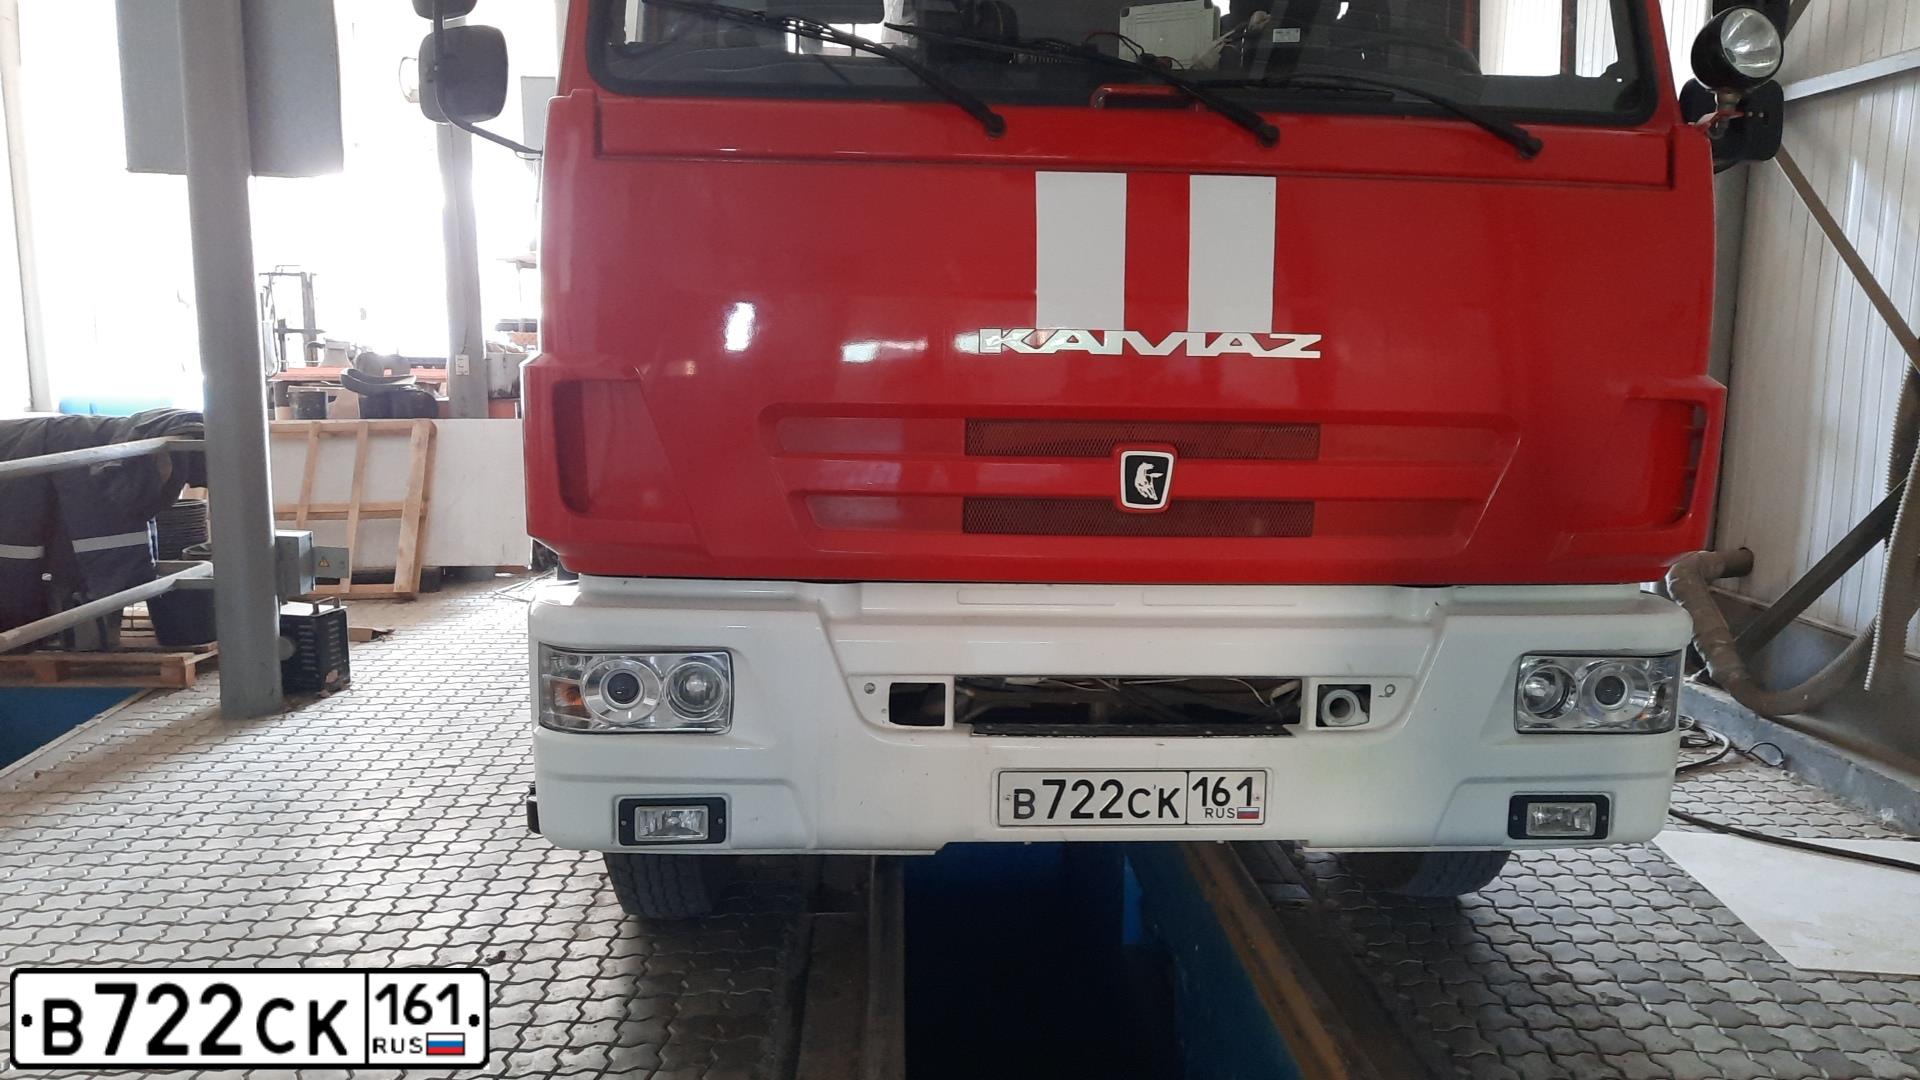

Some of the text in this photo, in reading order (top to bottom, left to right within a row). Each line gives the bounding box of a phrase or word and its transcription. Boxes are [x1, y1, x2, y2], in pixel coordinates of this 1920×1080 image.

[979, 328, 1321, 358] KAMAZ
[1191, 776, 1255, 807] 161
[1204, 807, 1236, 819] RUS
